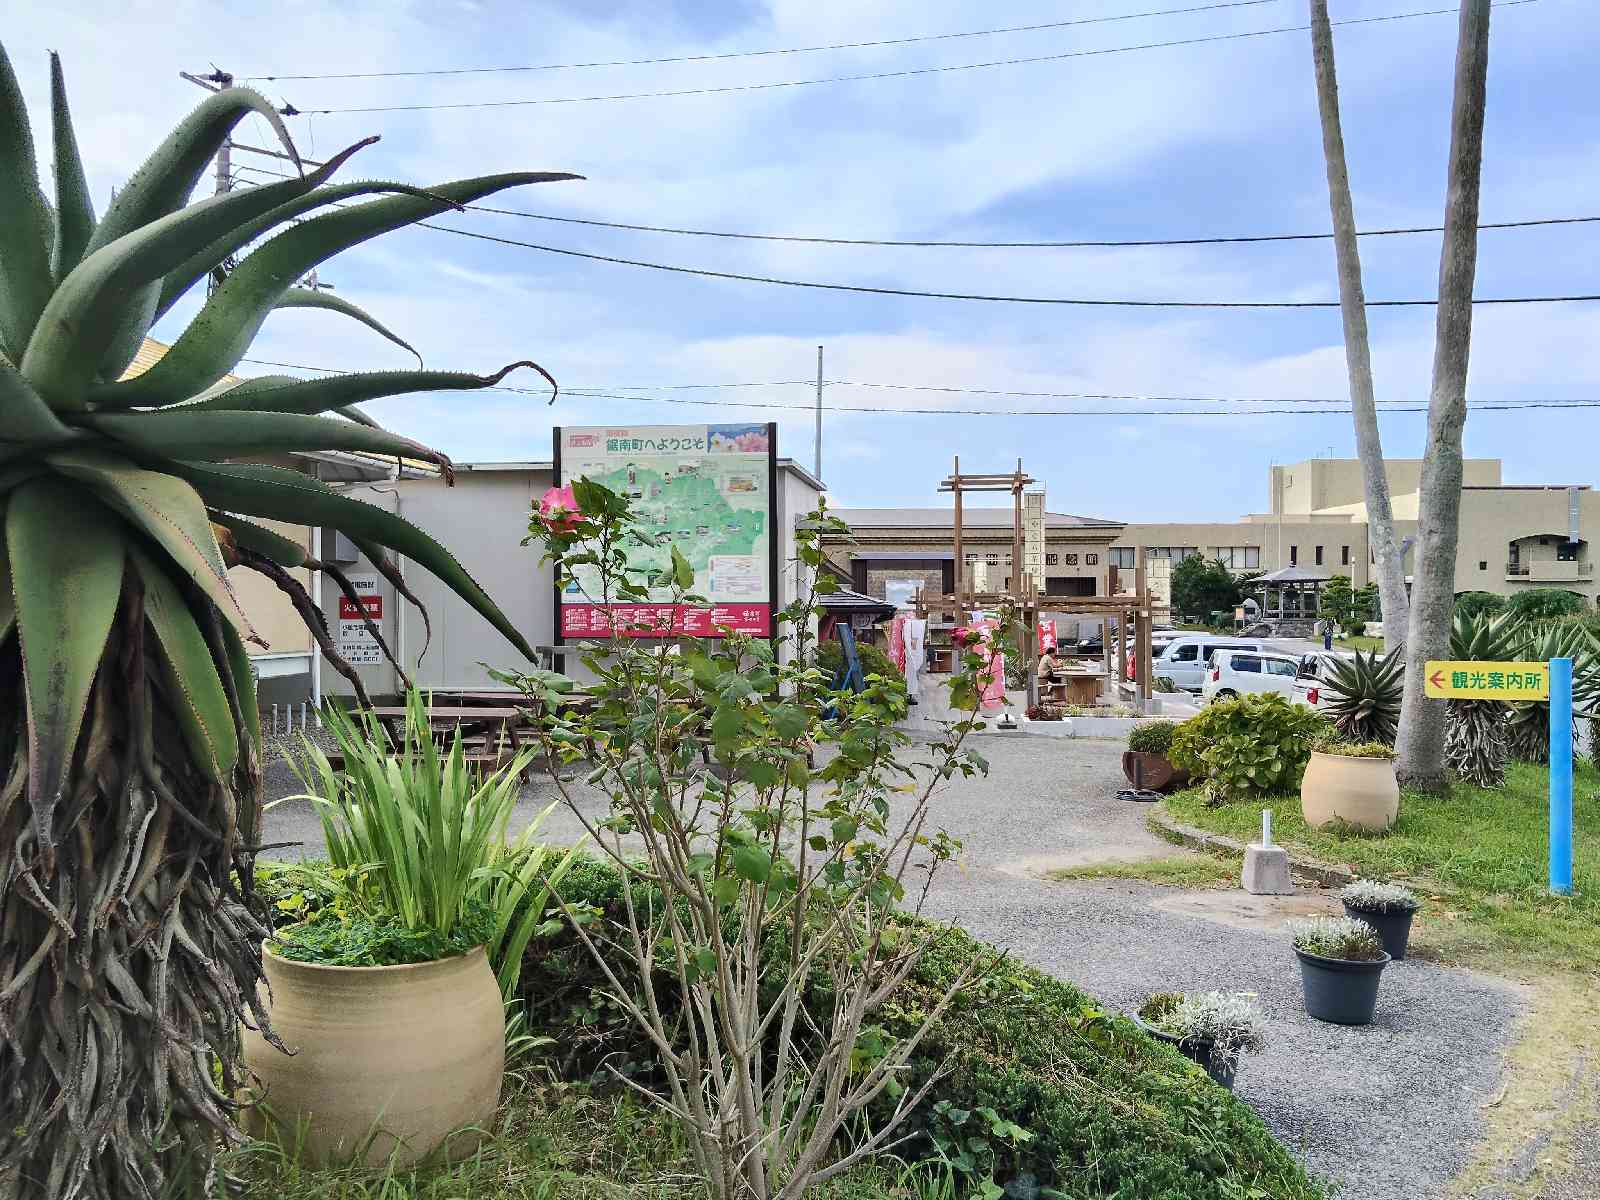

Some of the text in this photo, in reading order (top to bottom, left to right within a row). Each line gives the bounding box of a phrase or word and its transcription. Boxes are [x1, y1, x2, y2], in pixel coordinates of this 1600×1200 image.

[607, 438, 704, 452] 鋸南町へようこそ
[1452, 672, 1541, 690] 観光案内所
